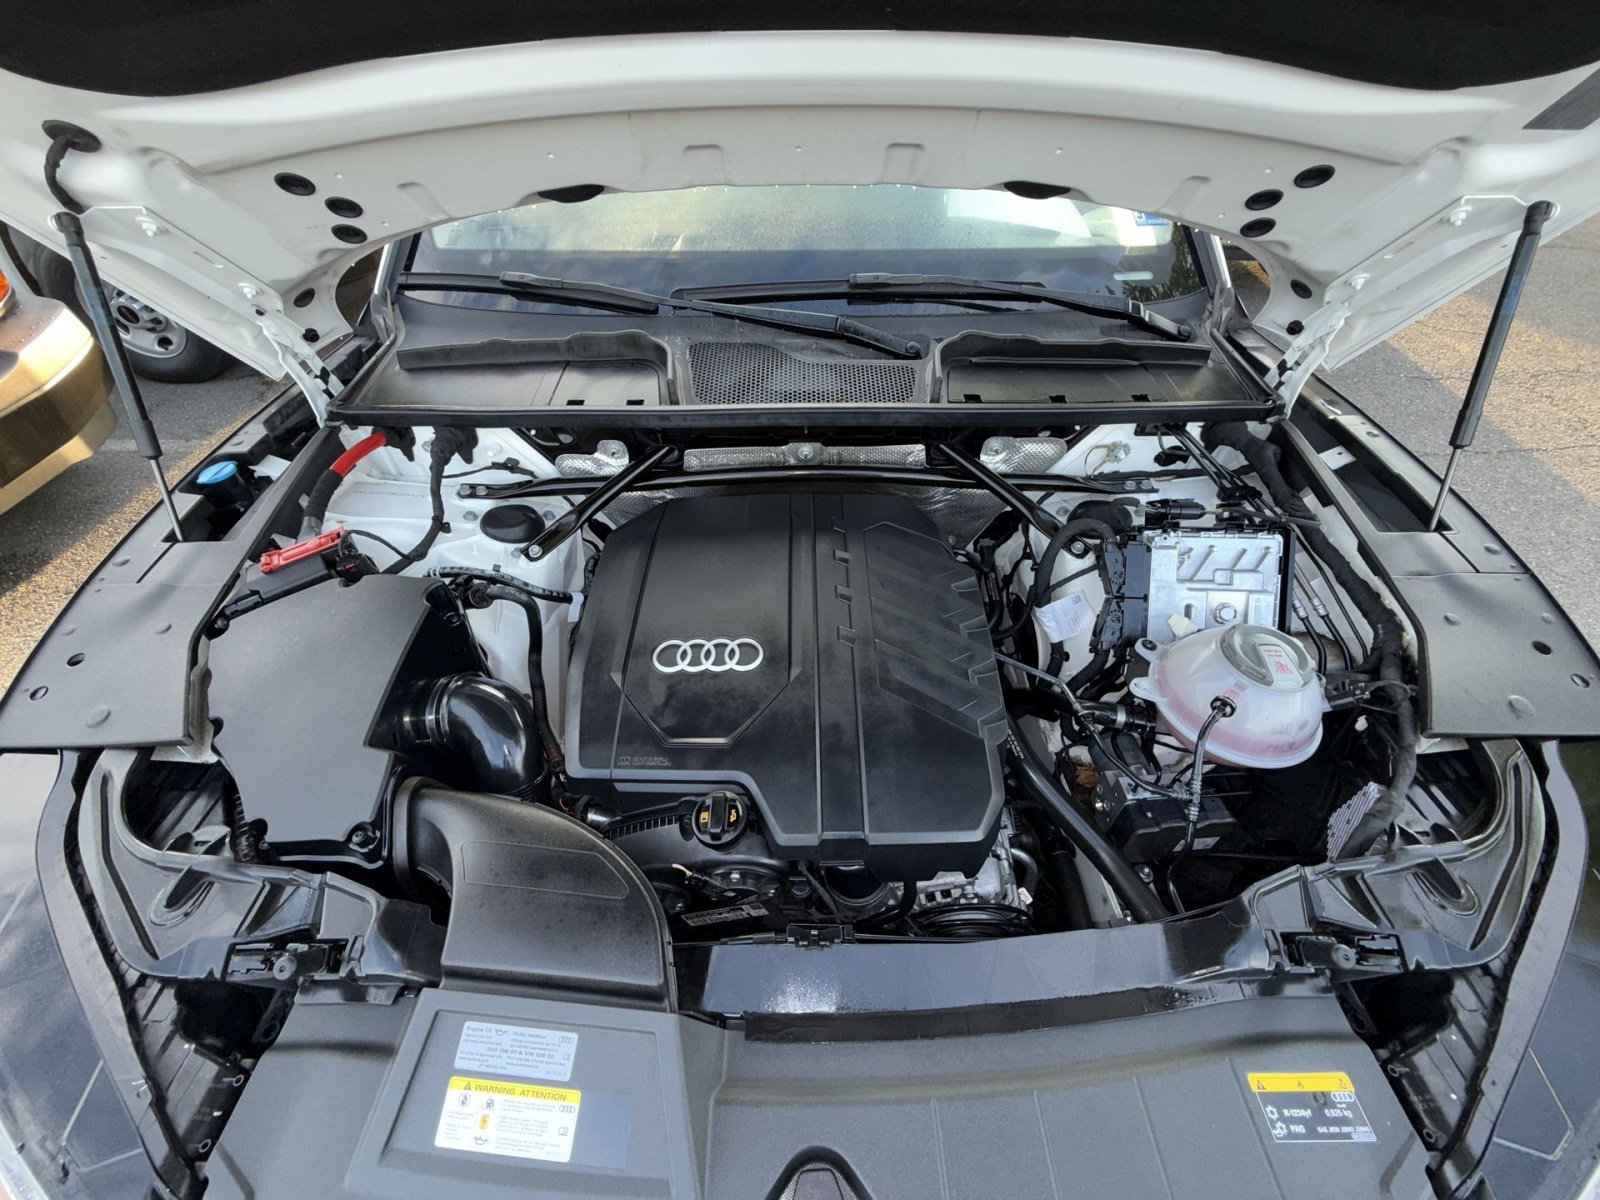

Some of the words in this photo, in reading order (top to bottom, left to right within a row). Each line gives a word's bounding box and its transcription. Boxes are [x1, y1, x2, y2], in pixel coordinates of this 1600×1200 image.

[474, 1084, 516, 1096] WARNING
[519, 1090, 567, 1102] ATTENTION
[1341, 1108, 1353, 1118] kg
[1290, 1125, 1306, 1133] PAG
